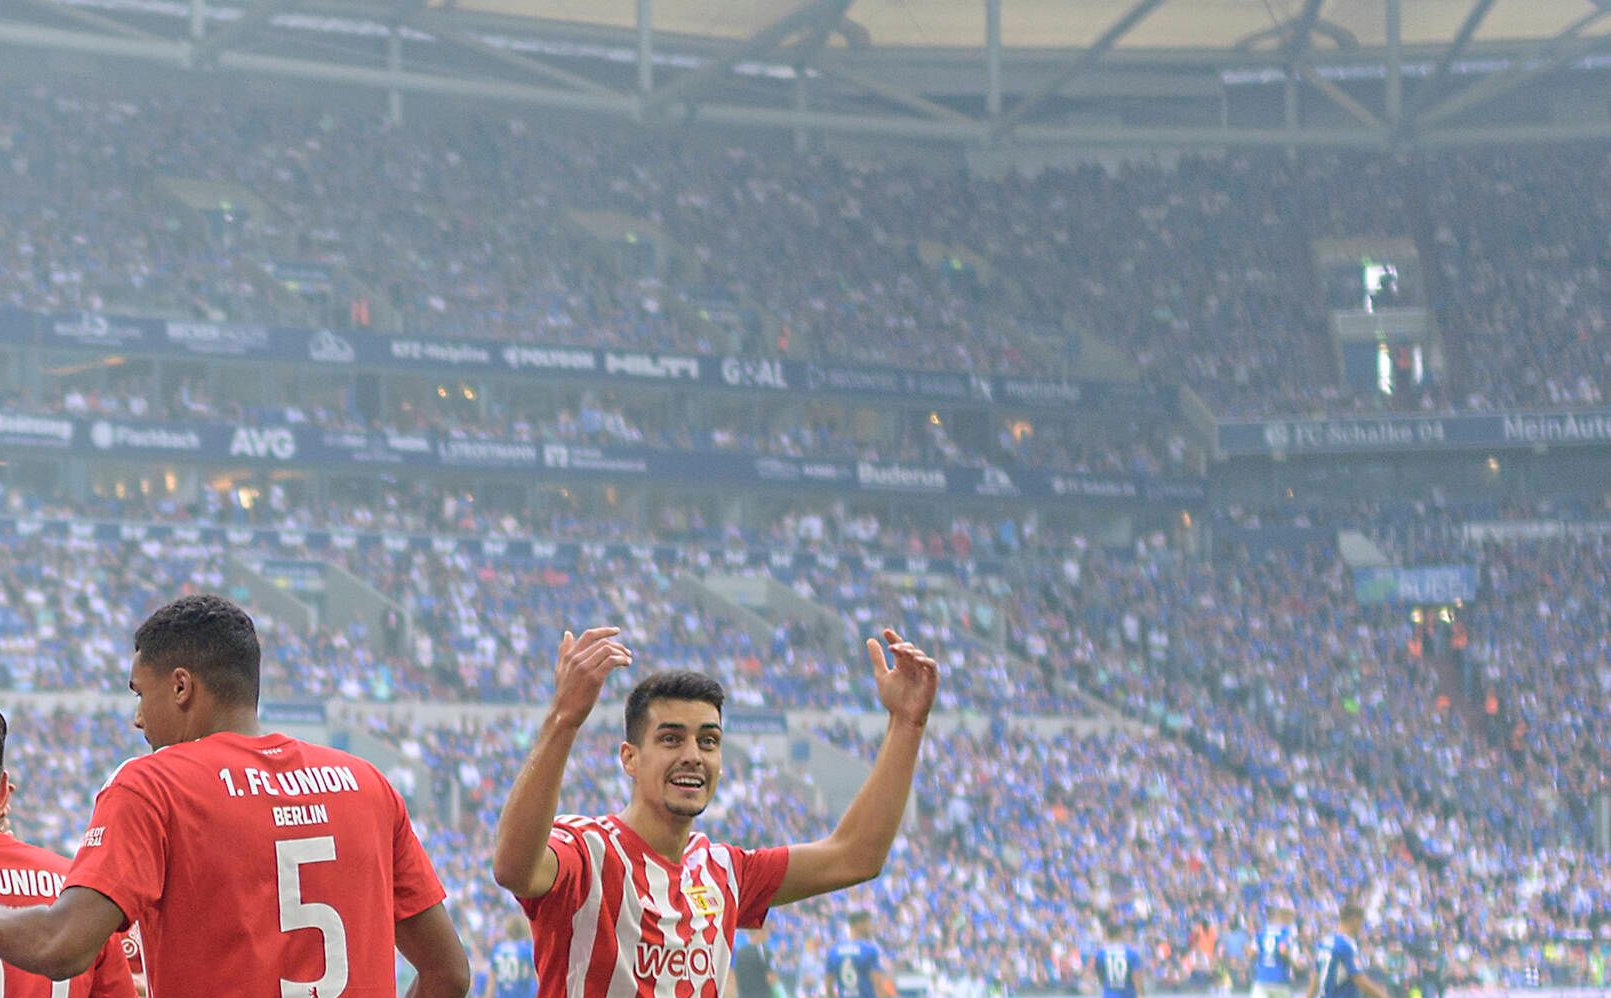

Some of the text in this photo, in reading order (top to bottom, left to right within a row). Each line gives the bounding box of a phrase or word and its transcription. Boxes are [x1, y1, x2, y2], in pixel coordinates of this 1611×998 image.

[229, 427, 295, 460] AVG
[219, 766, 359, 797] 1. FC UNION
[272, 804, 329, 827] BERLIN
[634, 943, 717, 979] weo
